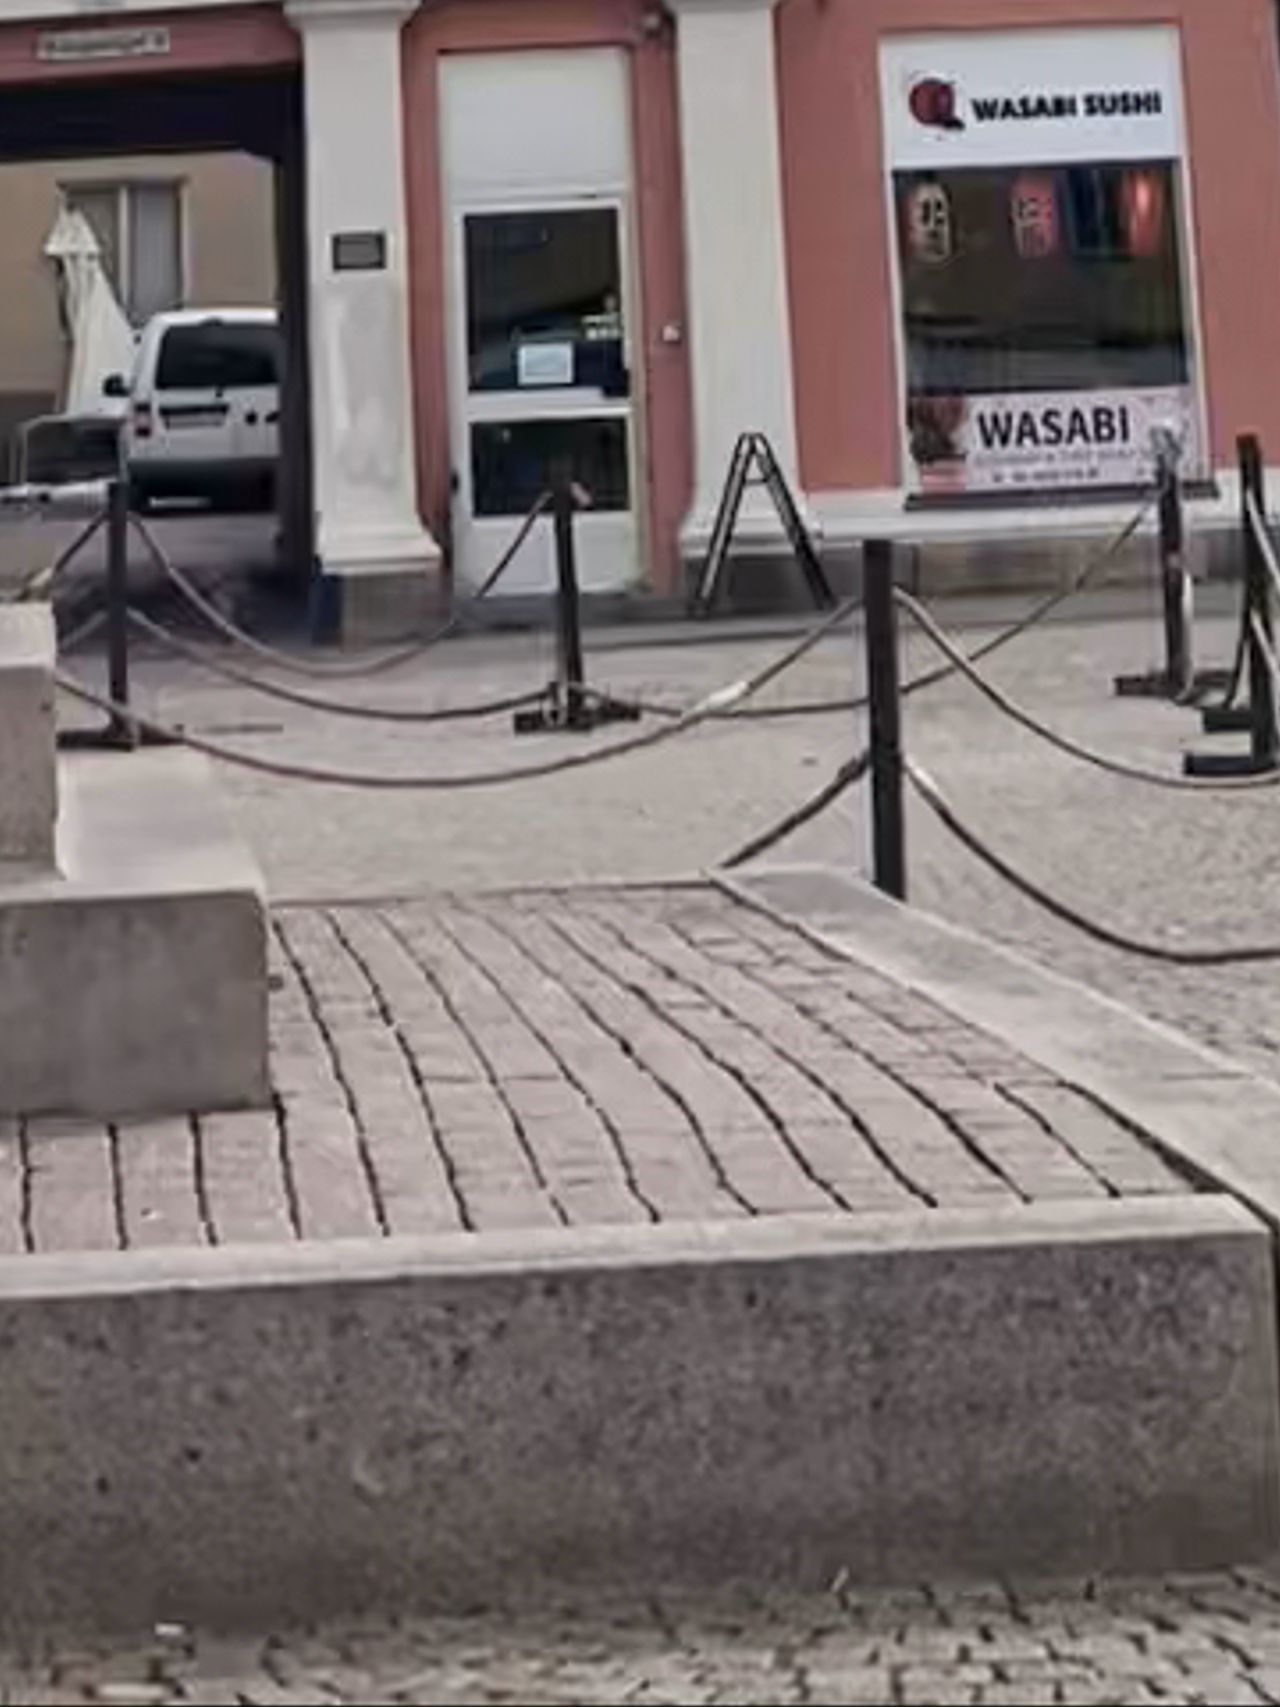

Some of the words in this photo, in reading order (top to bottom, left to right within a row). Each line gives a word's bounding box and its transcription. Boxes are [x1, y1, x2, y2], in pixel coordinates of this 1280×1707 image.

[971, 93, 1077, 122] WASABI
[1083, 91, 1162, 116] SUSHI
[977, 406, 1130, 449] WASABI
